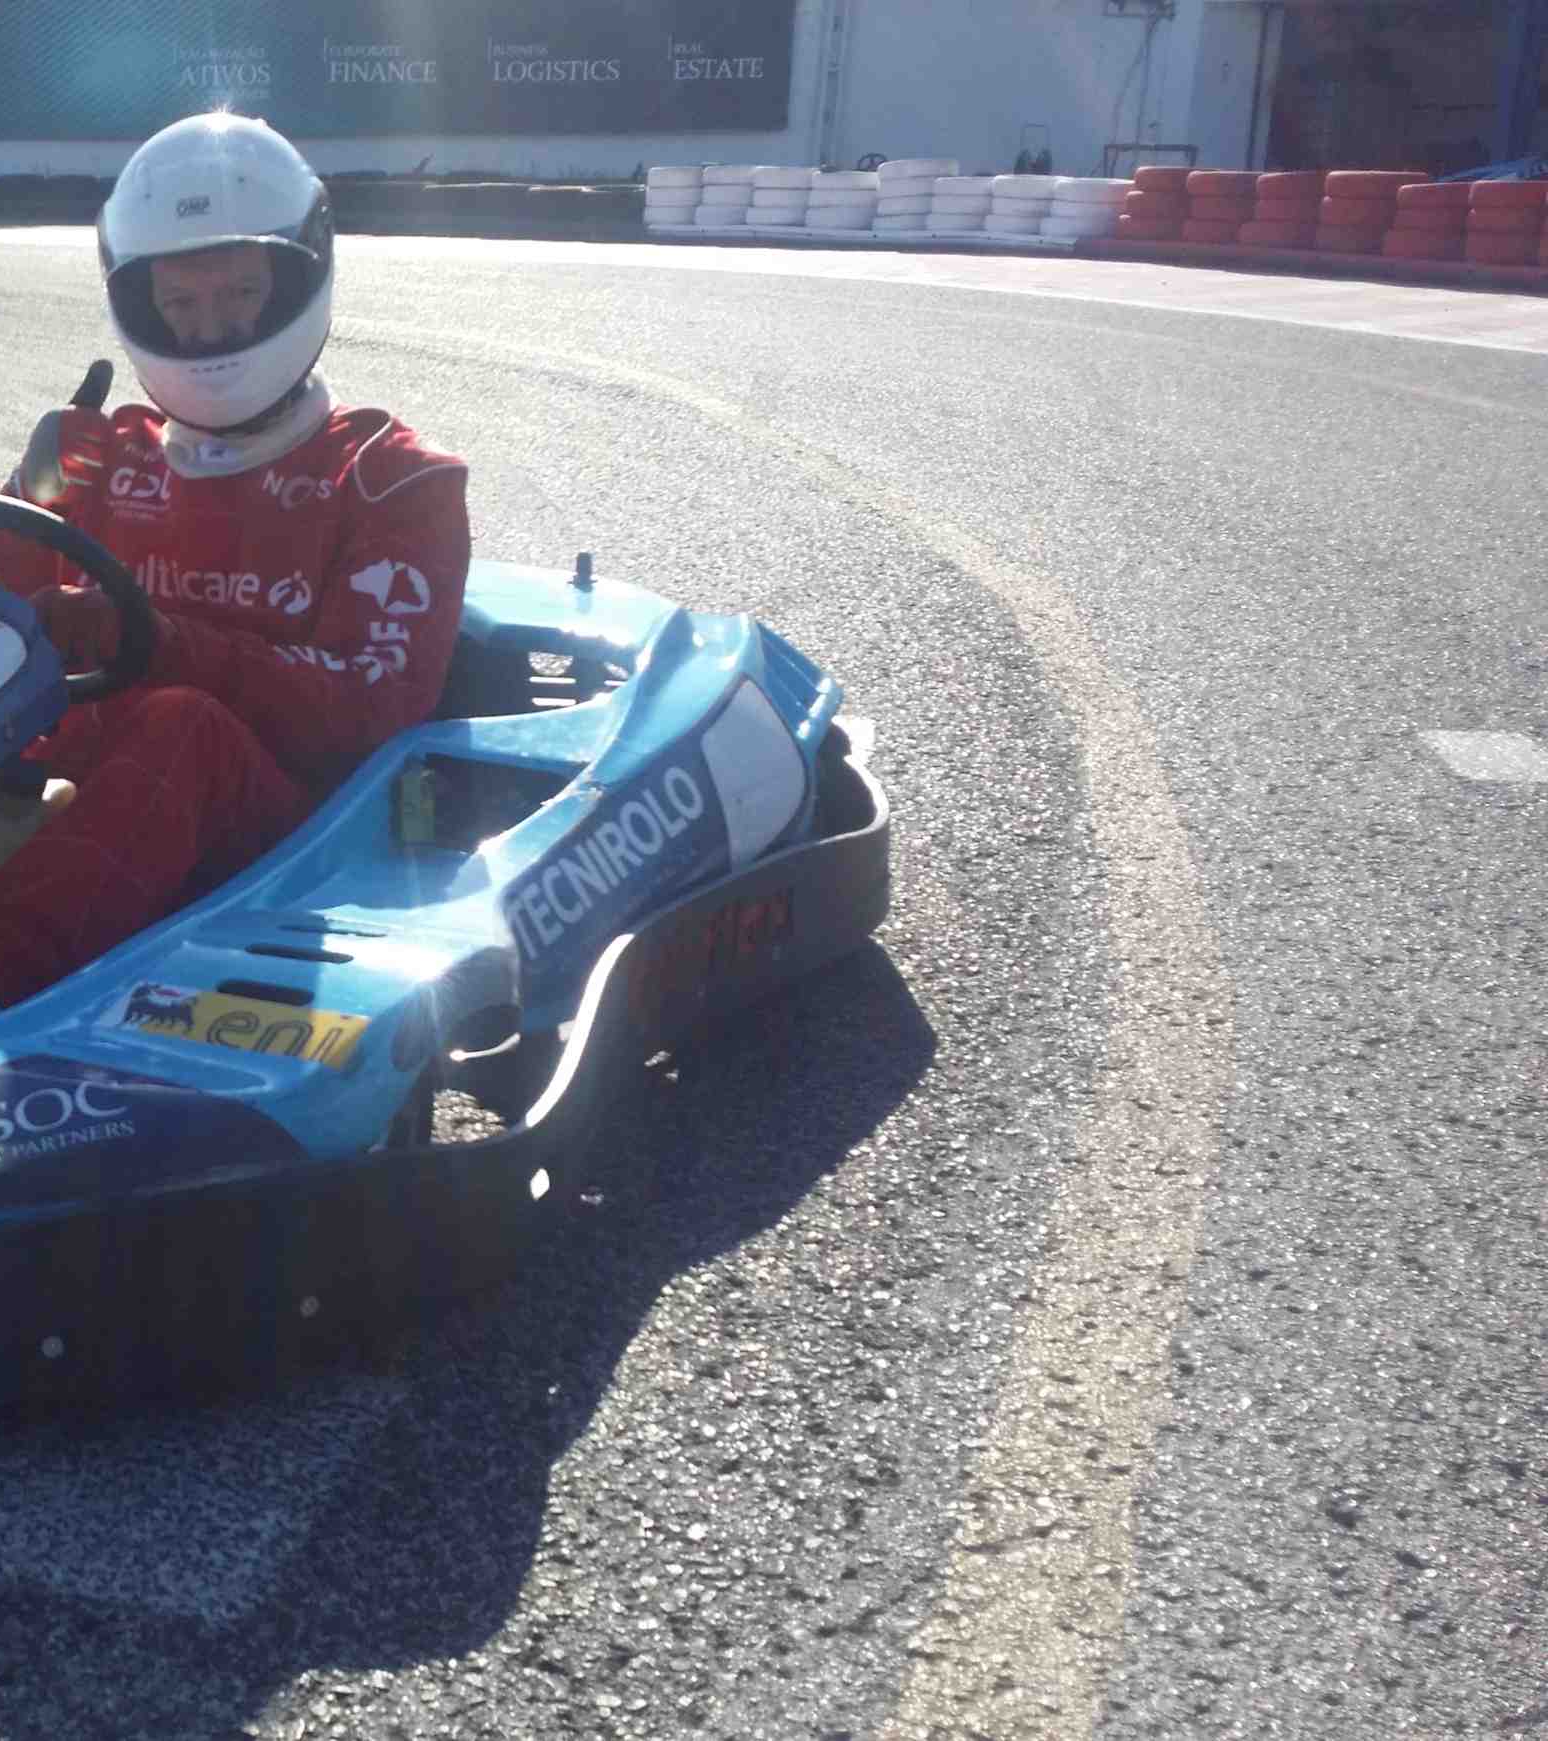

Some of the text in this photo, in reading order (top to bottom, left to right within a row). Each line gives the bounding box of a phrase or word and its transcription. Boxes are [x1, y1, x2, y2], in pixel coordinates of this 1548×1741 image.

[329, 61, 437, 83] FINANCE
[493, 58, 620, 81] LOGISTICS
[674, 57, 764, 80] ESTATE
[120, 553, 261, 607] ulticare
[506, 766, 705, 960] TECNIROLO
[207, 1011, 351, 1062] eni
[11, 1119, 136, 1159] PARTNERS
